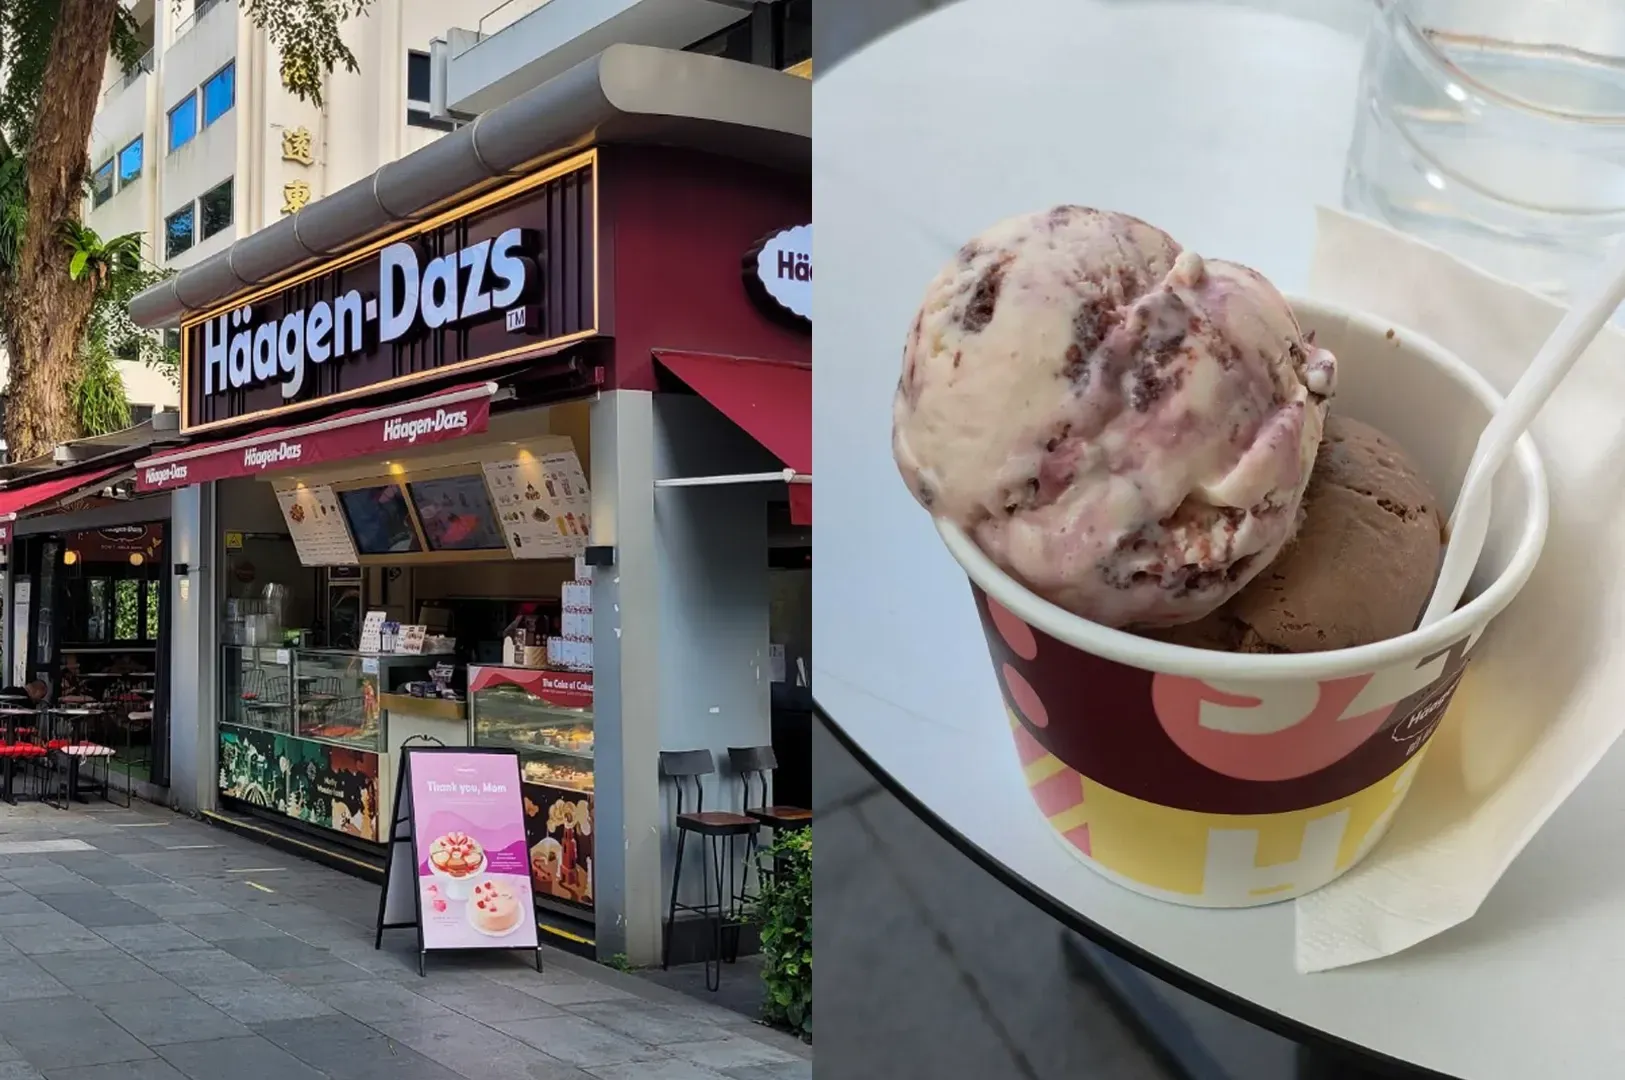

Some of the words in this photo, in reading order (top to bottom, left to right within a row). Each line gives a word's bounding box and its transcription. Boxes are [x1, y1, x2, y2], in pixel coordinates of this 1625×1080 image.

[777, 249, 812, 282] Hä
[204, 227, 526, 399] Häagen-Dazs
[383, 409, 468, 443] Häagen-Dazs
[244, 441, 302, 469] Häagen-Dazs
[145, 463, 188, 486] Häagen-Dazs
[426, 780, 457, 792] Thank
[459, 783, 481, 796] you,
[482, 782, 507, 793] Mom
